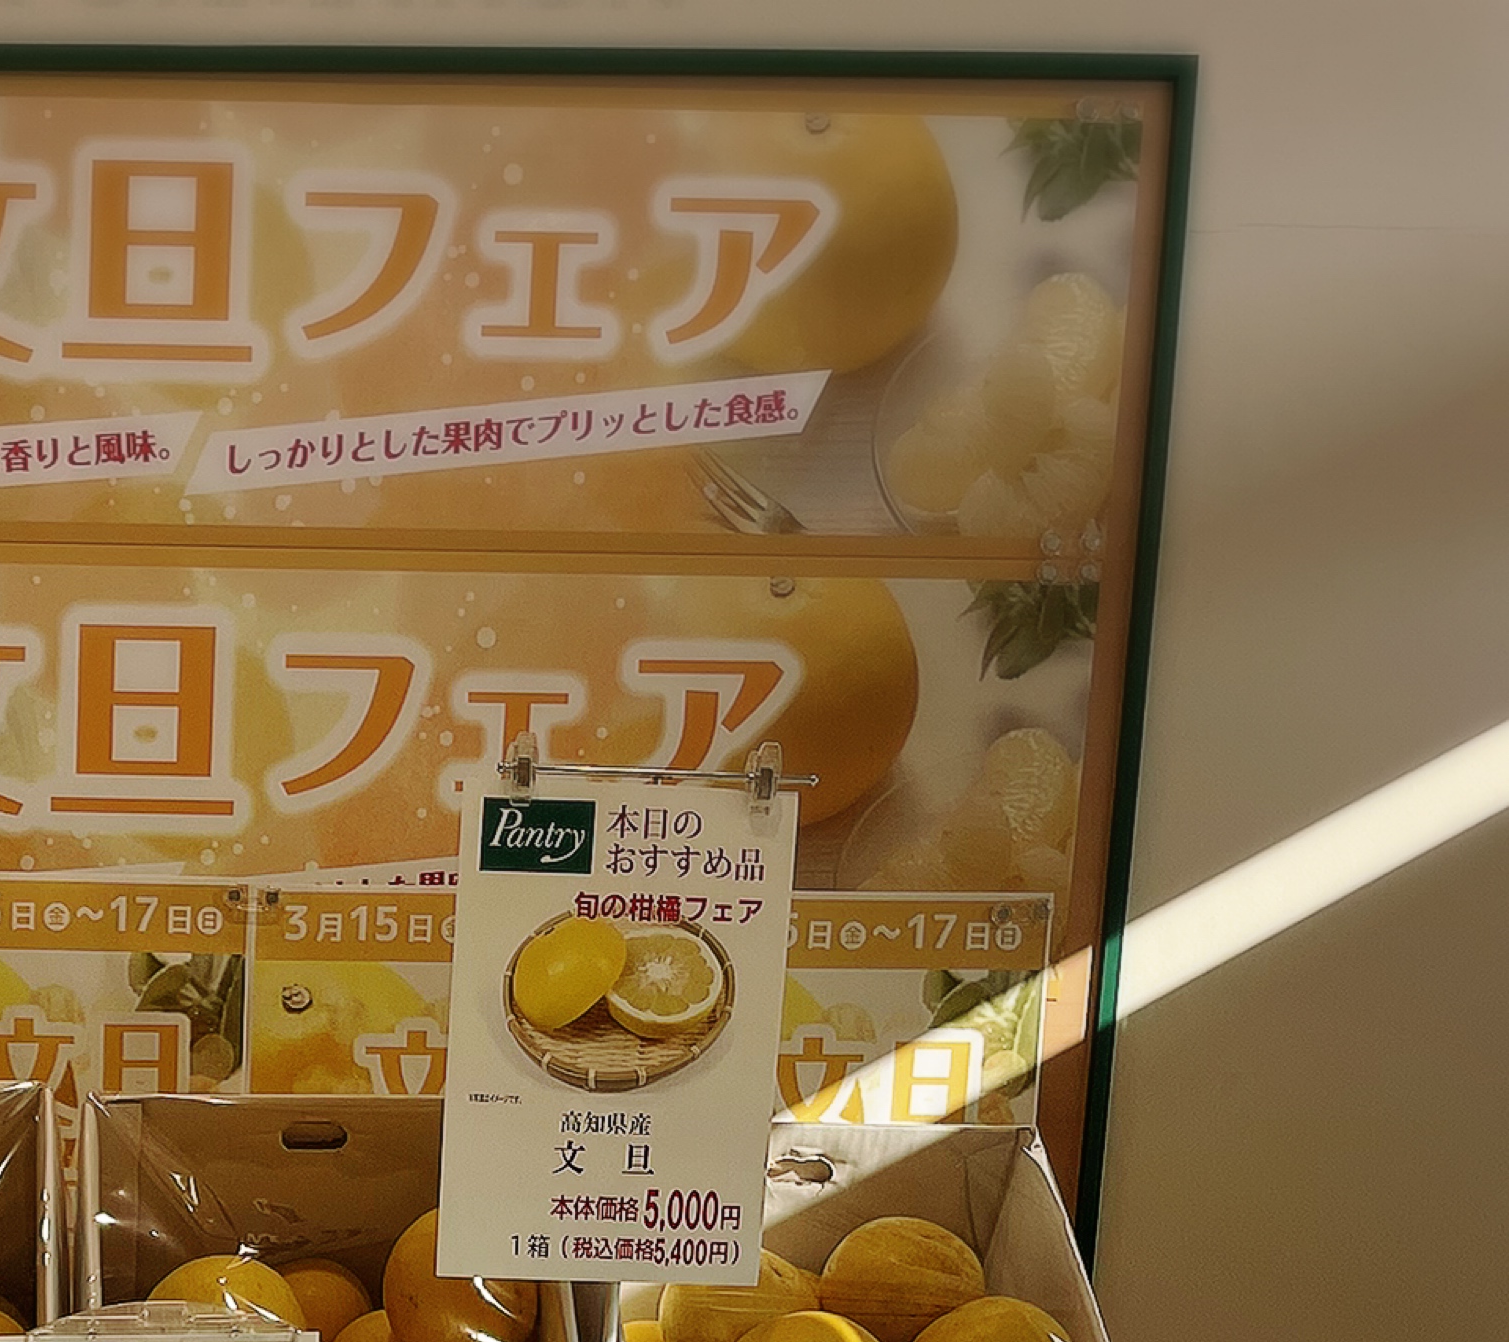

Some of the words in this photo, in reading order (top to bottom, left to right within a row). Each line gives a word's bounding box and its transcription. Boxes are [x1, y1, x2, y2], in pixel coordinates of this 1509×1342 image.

[489, 806, 586, 864] Pantry
[606, 804, 703, 839] 本日の
[605, 843, 765, 882] おすすめ品
[574, 891, 763, 924] 旬の柑橘フェア
[560, 1111, 651, 1137] 高知県産
